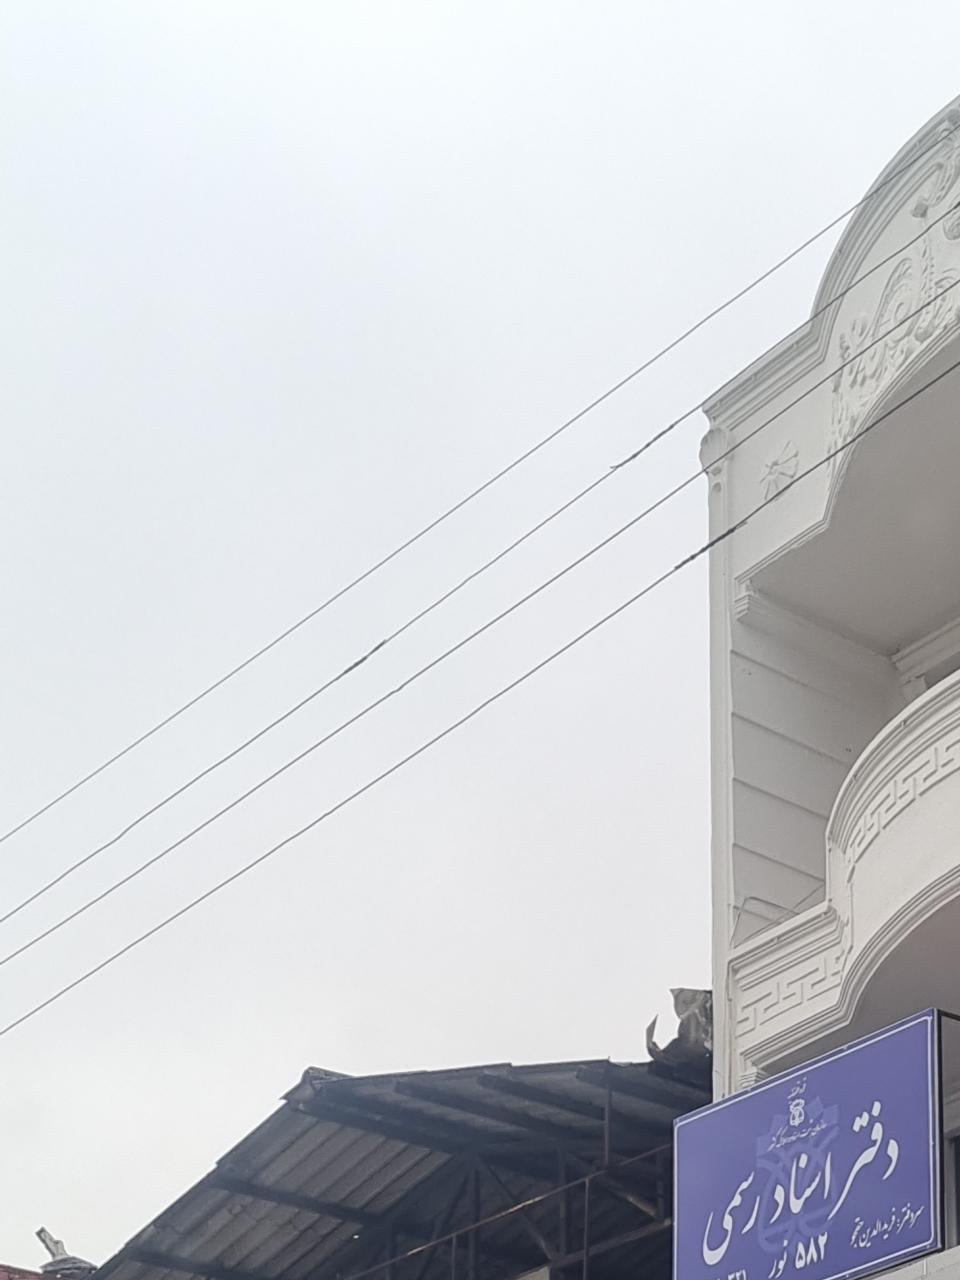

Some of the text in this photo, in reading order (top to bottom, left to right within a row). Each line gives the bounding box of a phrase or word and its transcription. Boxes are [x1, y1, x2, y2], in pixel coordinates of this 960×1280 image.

[702, 1101, 899, 1266] دفتر اسناد رسمی
[768, 1231, 828, 1280] ۵۸۲ نور
